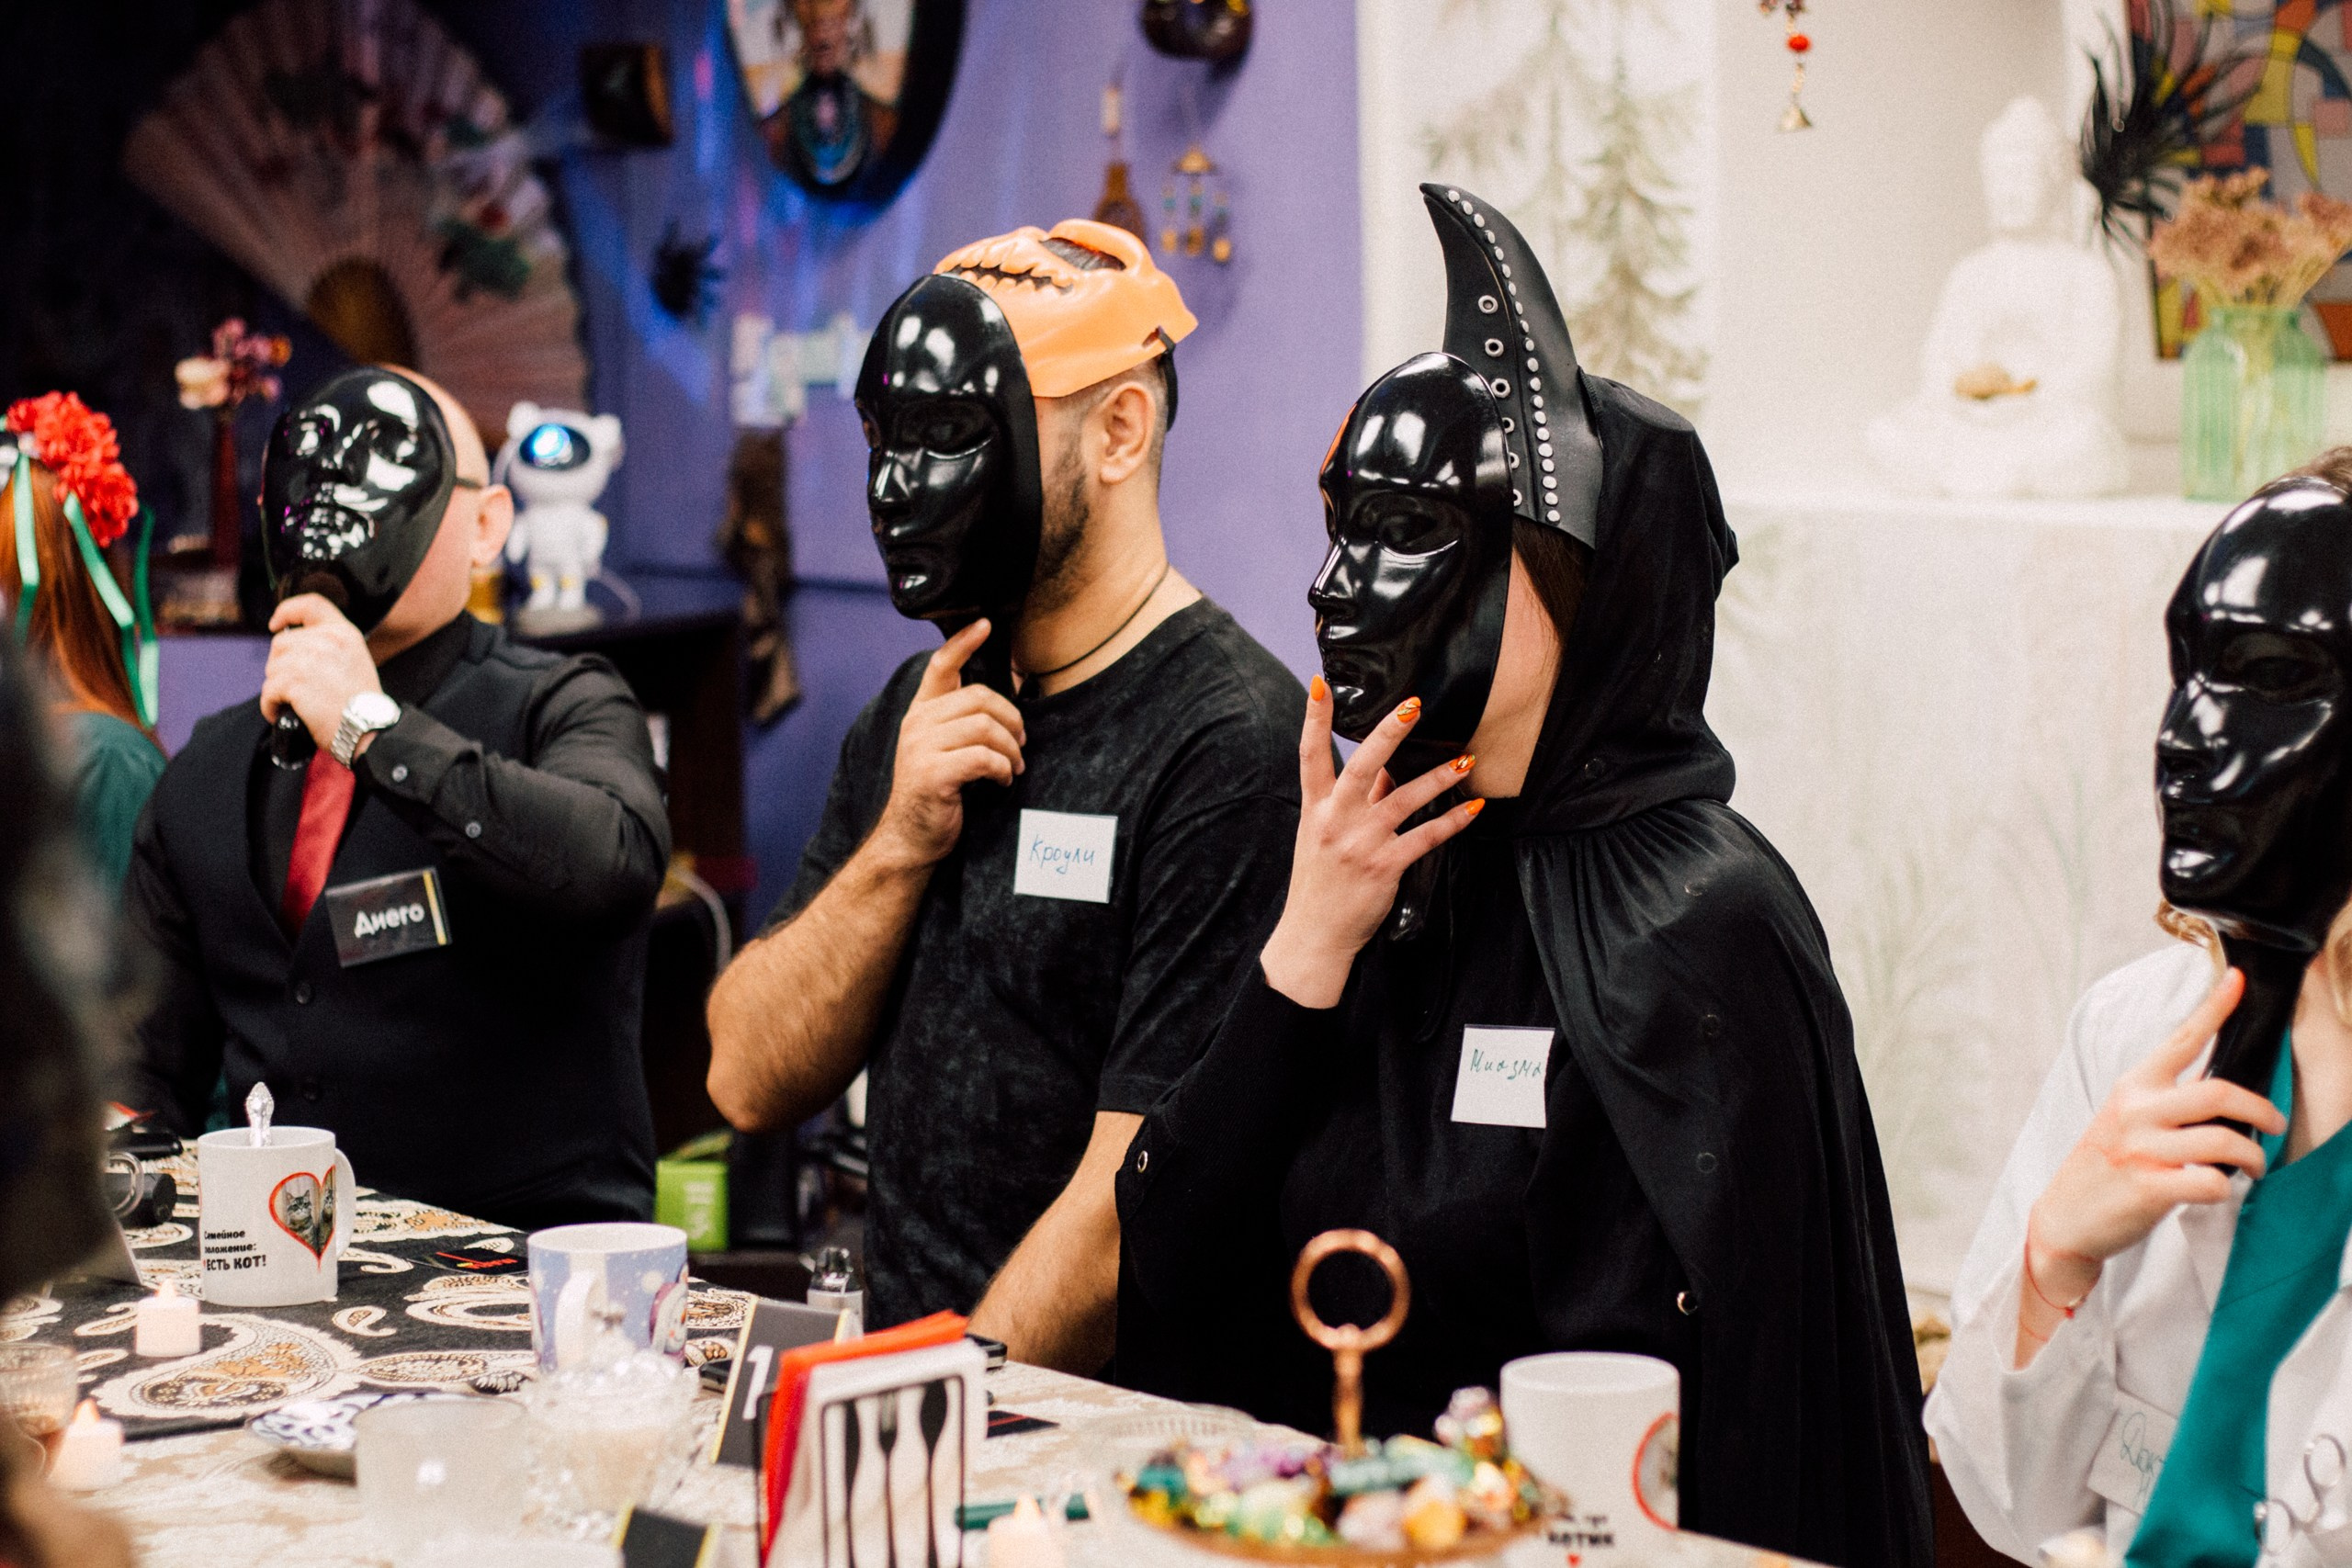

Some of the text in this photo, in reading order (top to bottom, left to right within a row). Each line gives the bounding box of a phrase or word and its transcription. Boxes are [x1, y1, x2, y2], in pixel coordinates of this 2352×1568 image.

[1029, 833, 1095, 874] Кроули
[354, 903, 425, 938] Диего
[207, 1255, 266, 1270] ЕСТЬ КОТ!
